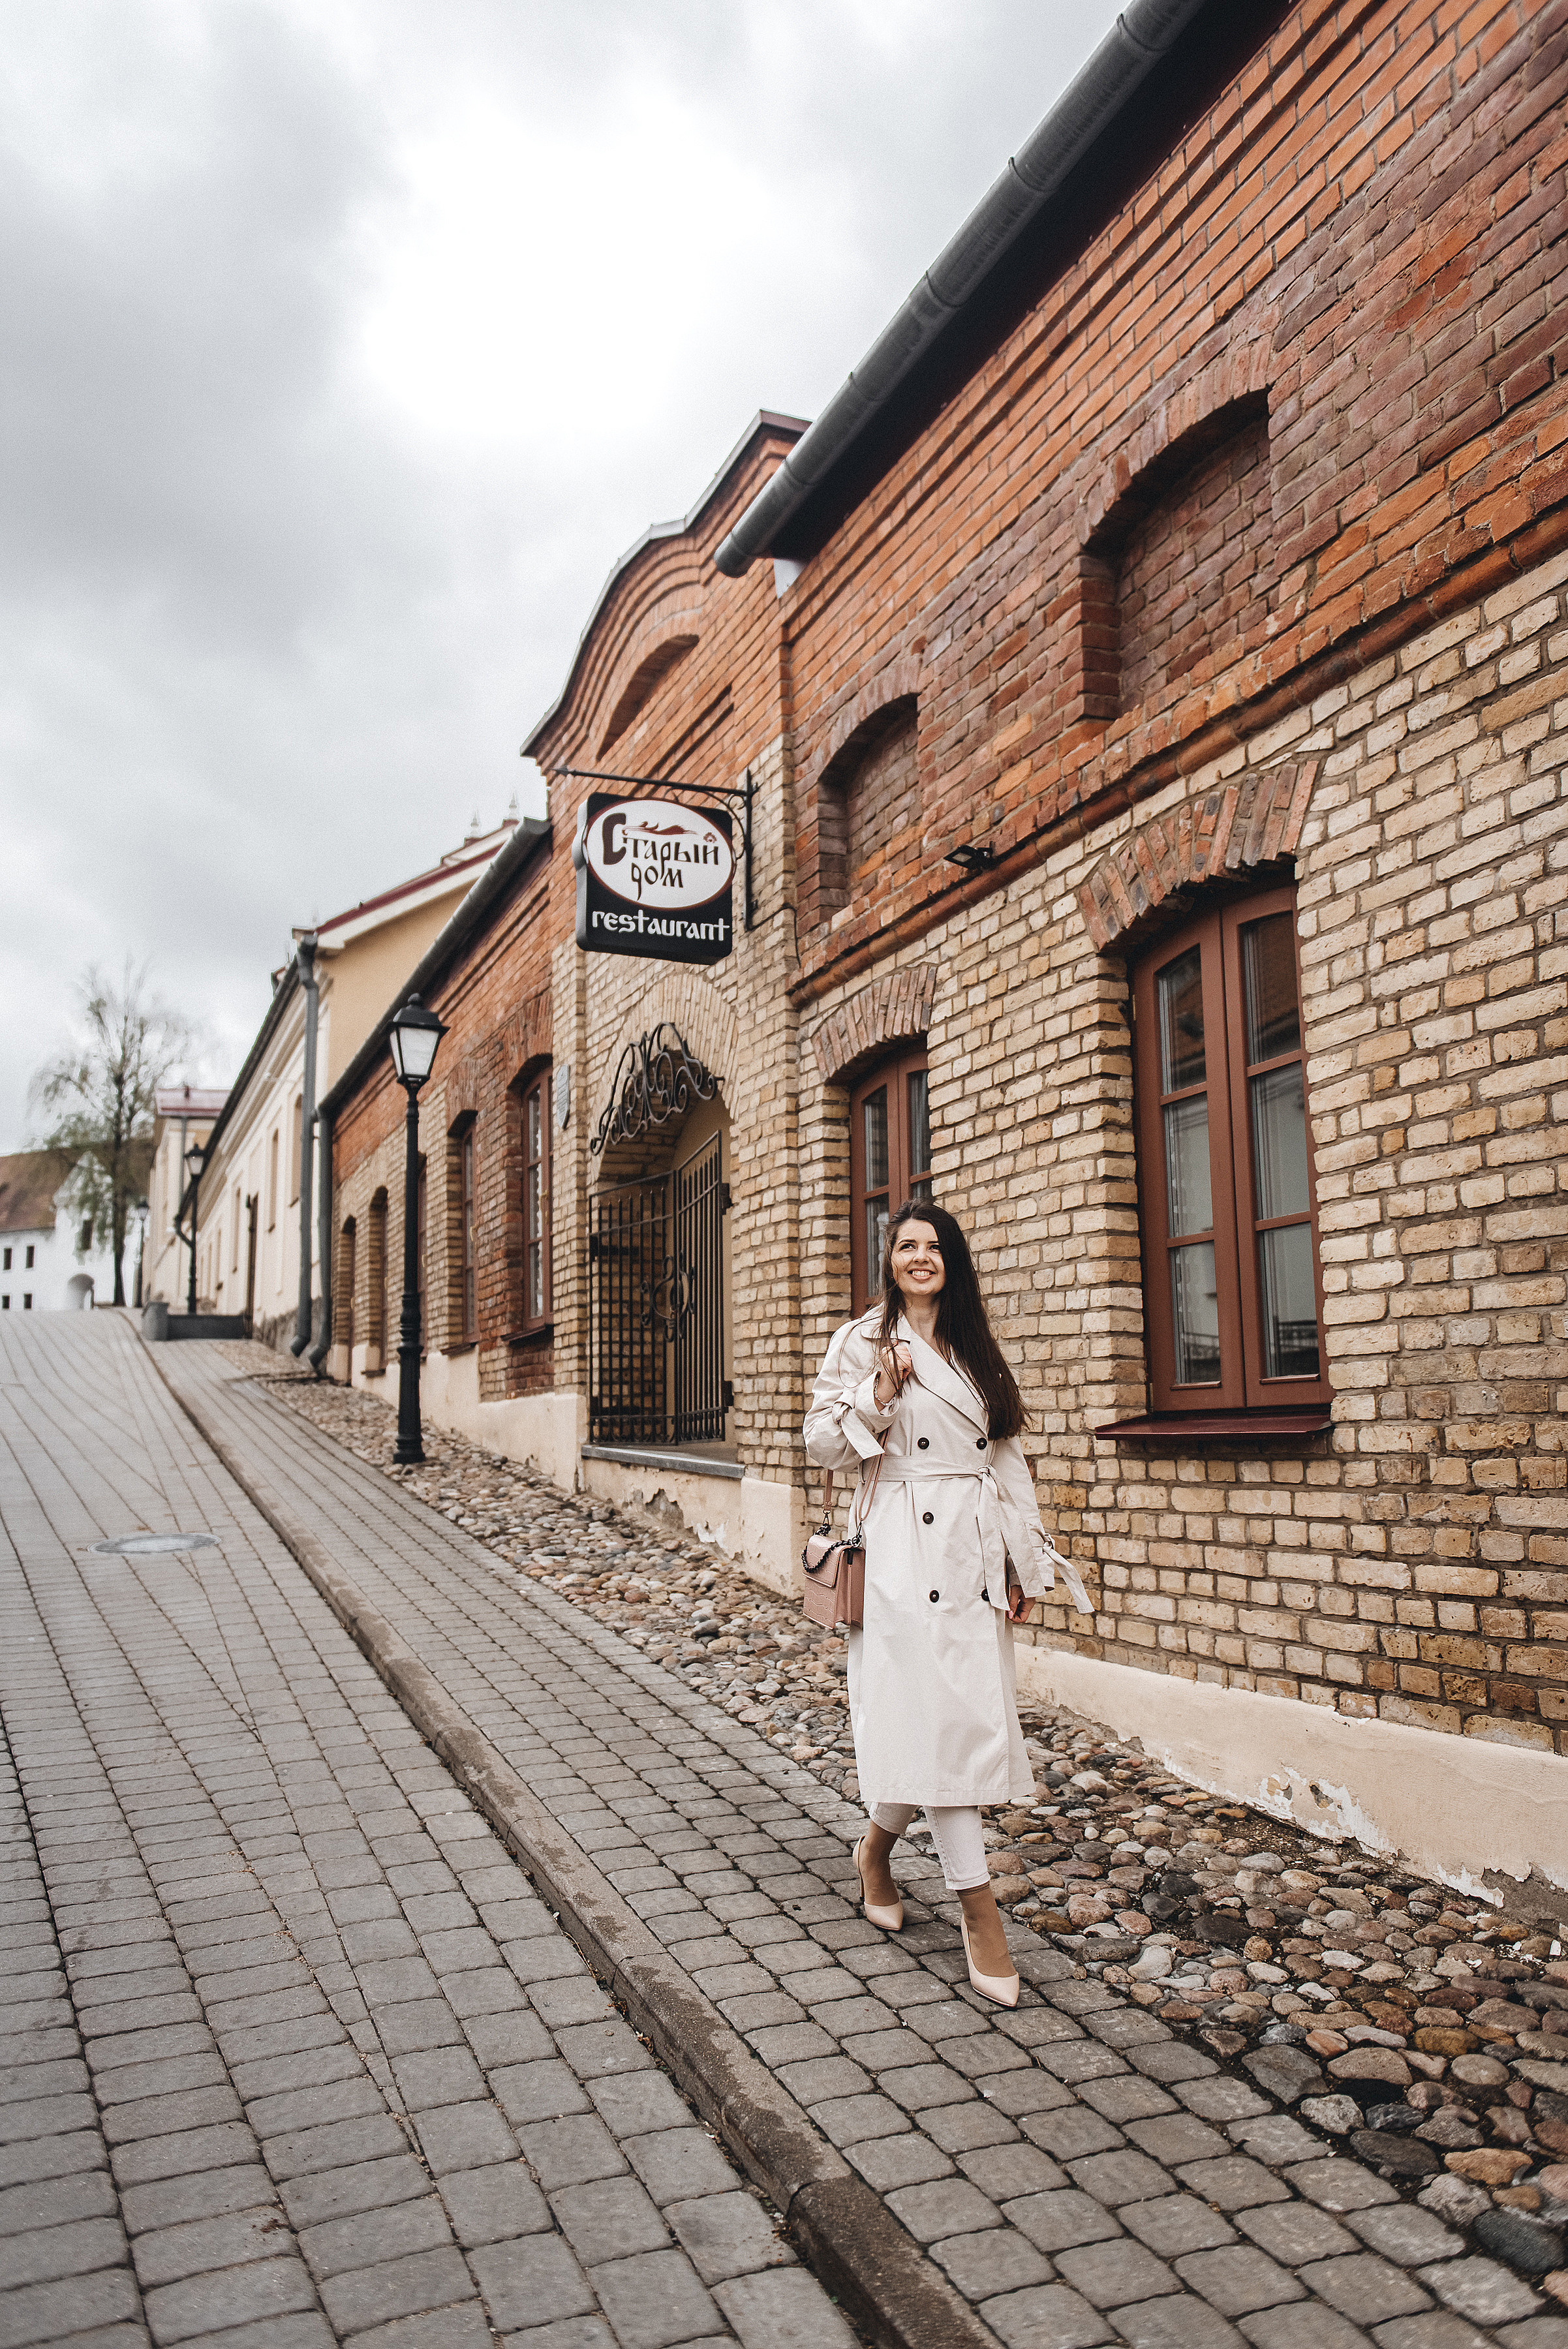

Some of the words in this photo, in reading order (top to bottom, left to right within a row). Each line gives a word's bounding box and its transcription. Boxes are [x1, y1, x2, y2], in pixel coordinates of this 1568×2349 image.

[602, 813, 719, 880] Старый
[631, 863, 683, 900] дом
[592, 910, 730, 941] restaurant
